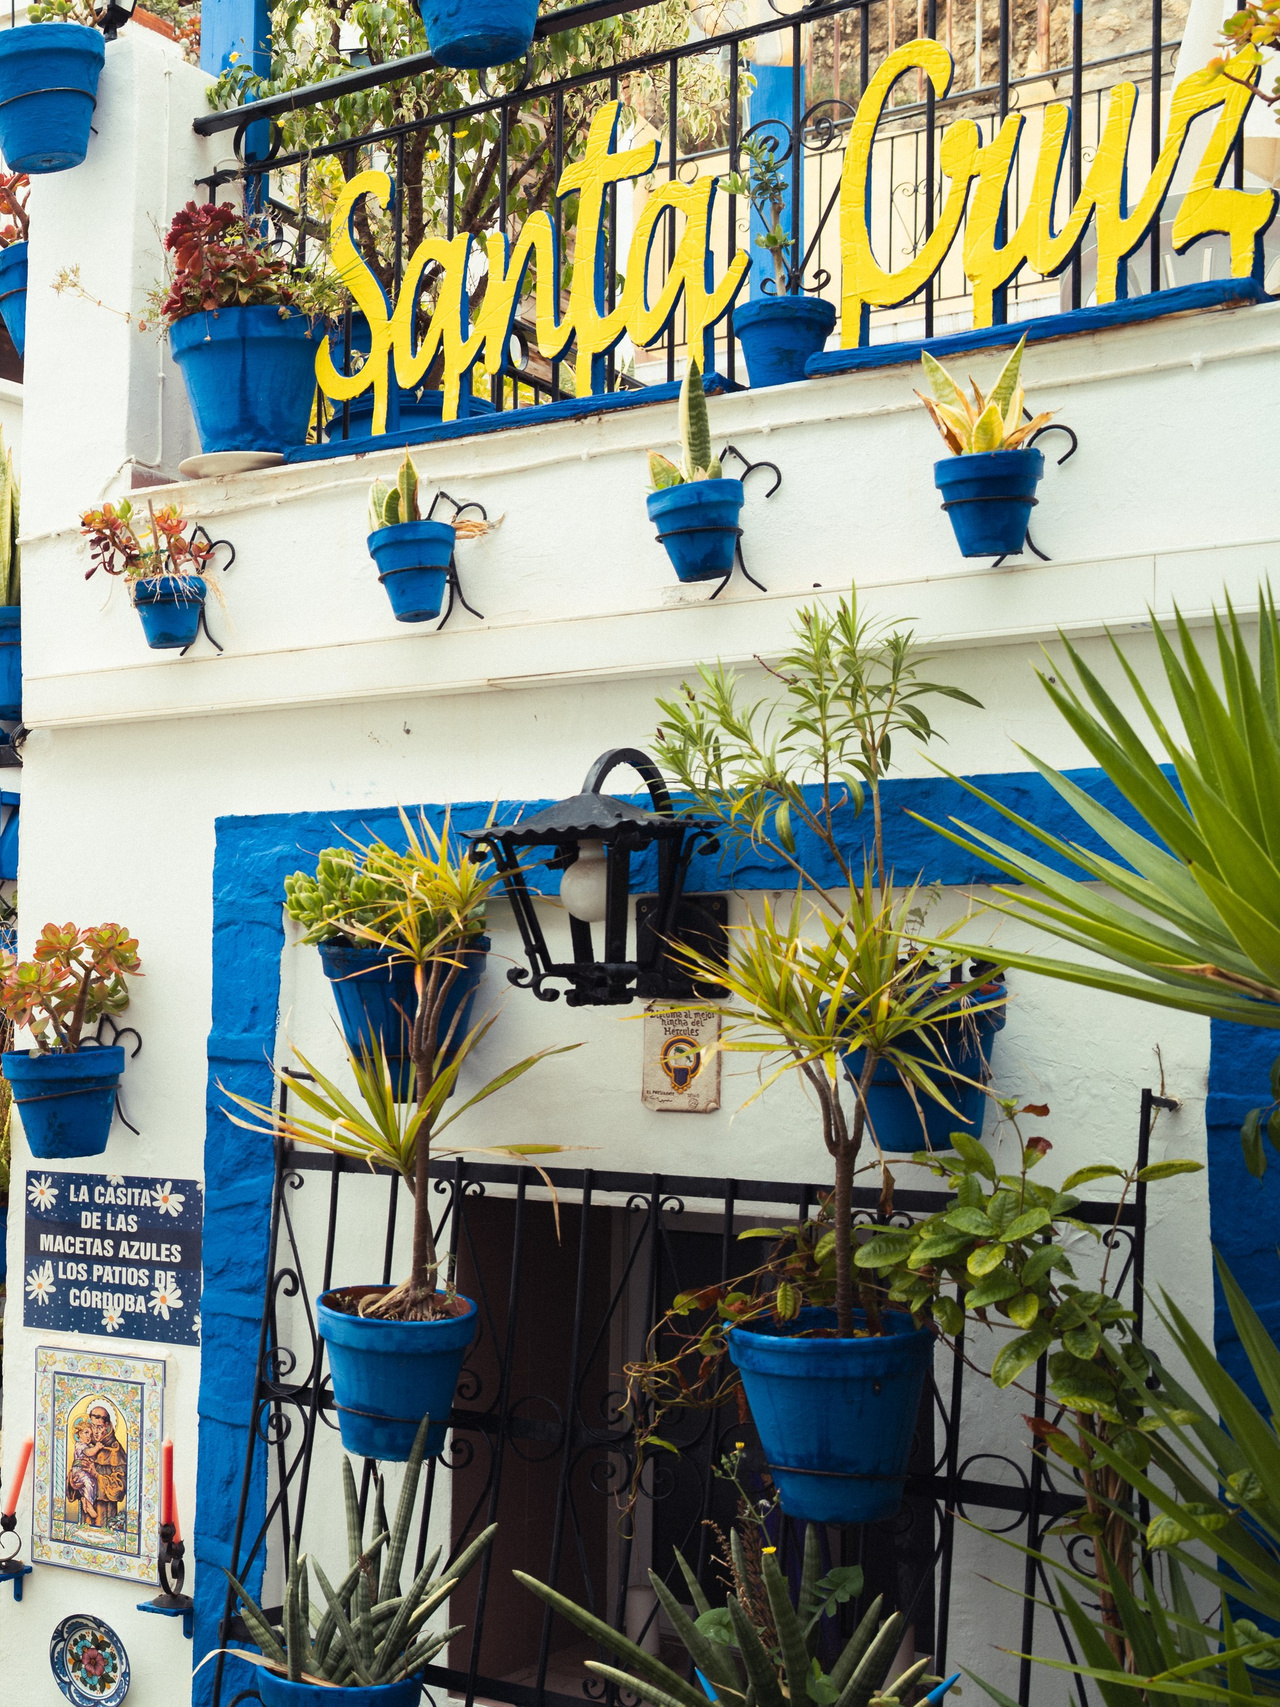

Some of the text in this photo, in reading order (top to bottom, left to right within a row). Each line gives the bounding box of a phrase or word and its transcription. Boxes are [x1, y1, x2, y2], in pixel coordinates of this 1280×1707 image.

[314, 38, 1279, 434] Santa Cruz
[70, 1184, 152, 1207] LA CASITA
[81, 1211, 138, 1232] DE LAS
[39, 1234, 182, 1263] MACETAS AZULES
[43, 1260, 177, 1288] A LOS PATIOS DE
[69, 1286, 147, 1313] CÓRDOBA
